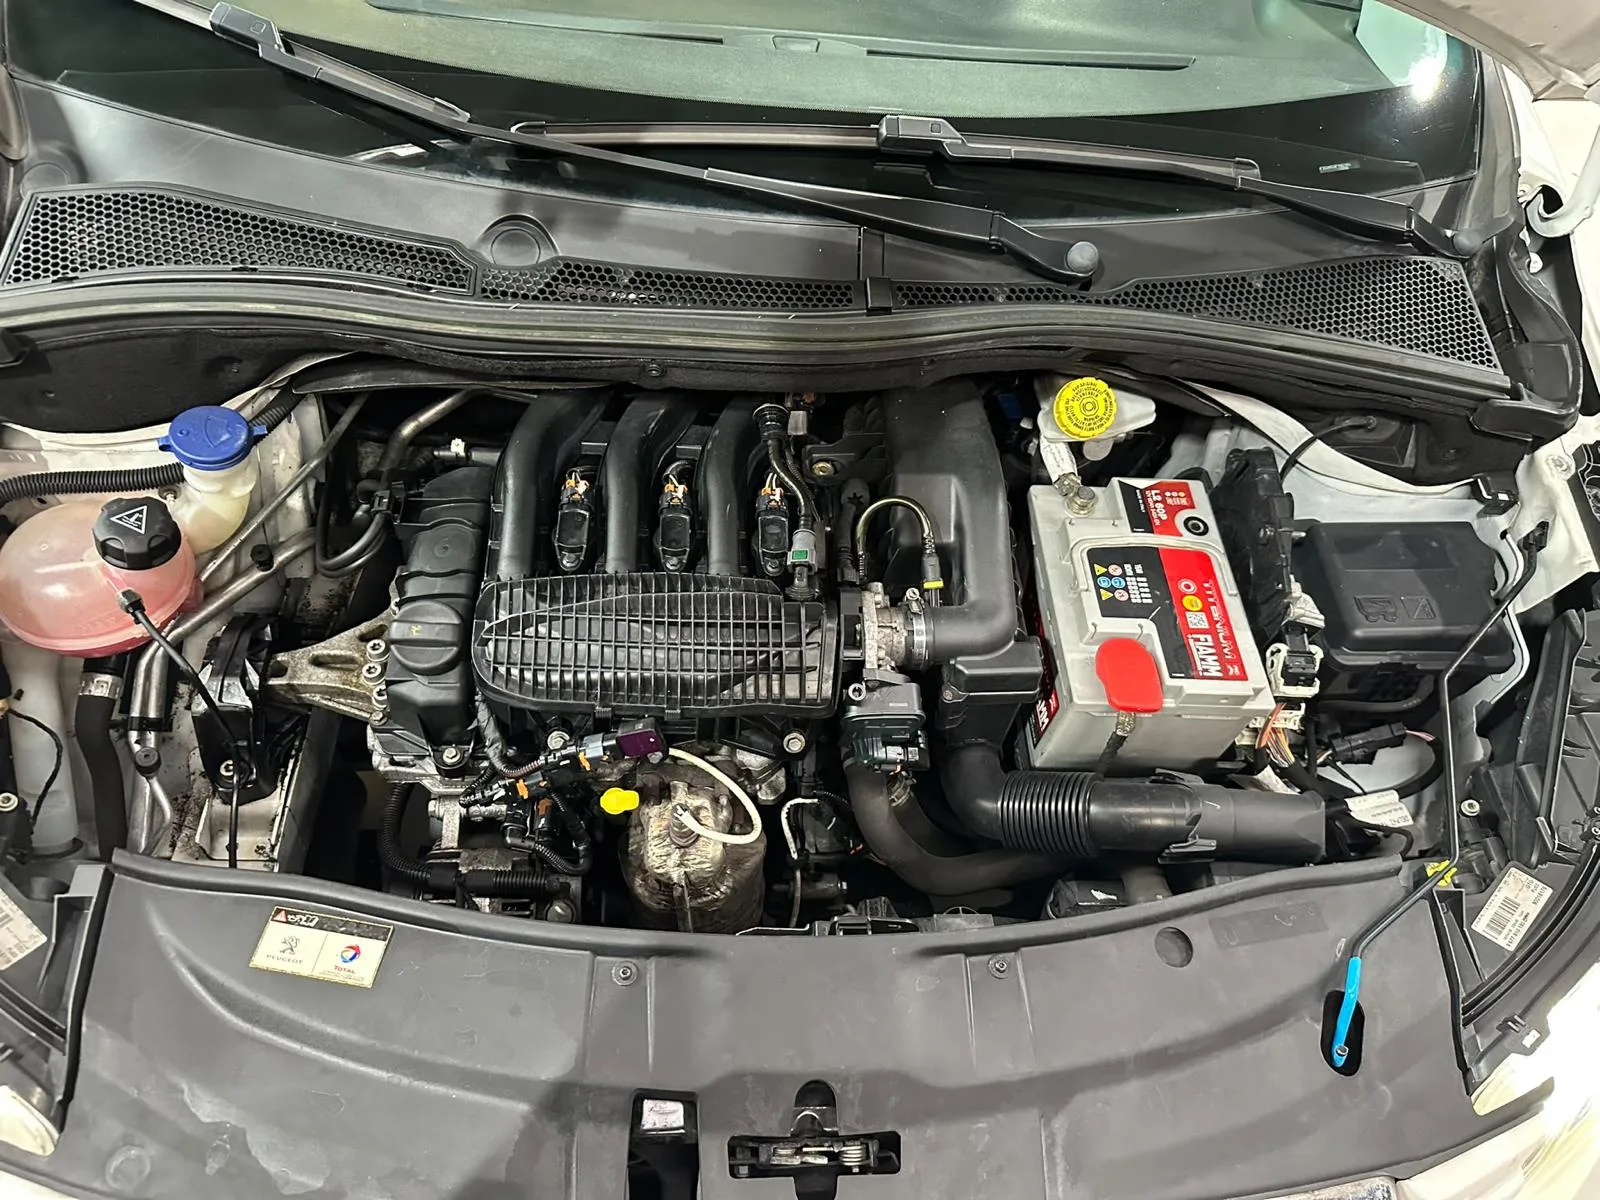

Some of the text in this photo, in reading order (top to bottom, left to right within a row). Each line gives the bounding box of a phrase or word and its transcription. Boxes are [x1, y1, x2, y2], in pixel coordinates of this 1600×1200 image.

[1151, 490, 1168, 520] L2 60P
[1191, 634, 1223, 677] FIAMM
[266, 954, 302, 964] PEUGEOT
[334, 965, 355, 974] TOTAL
